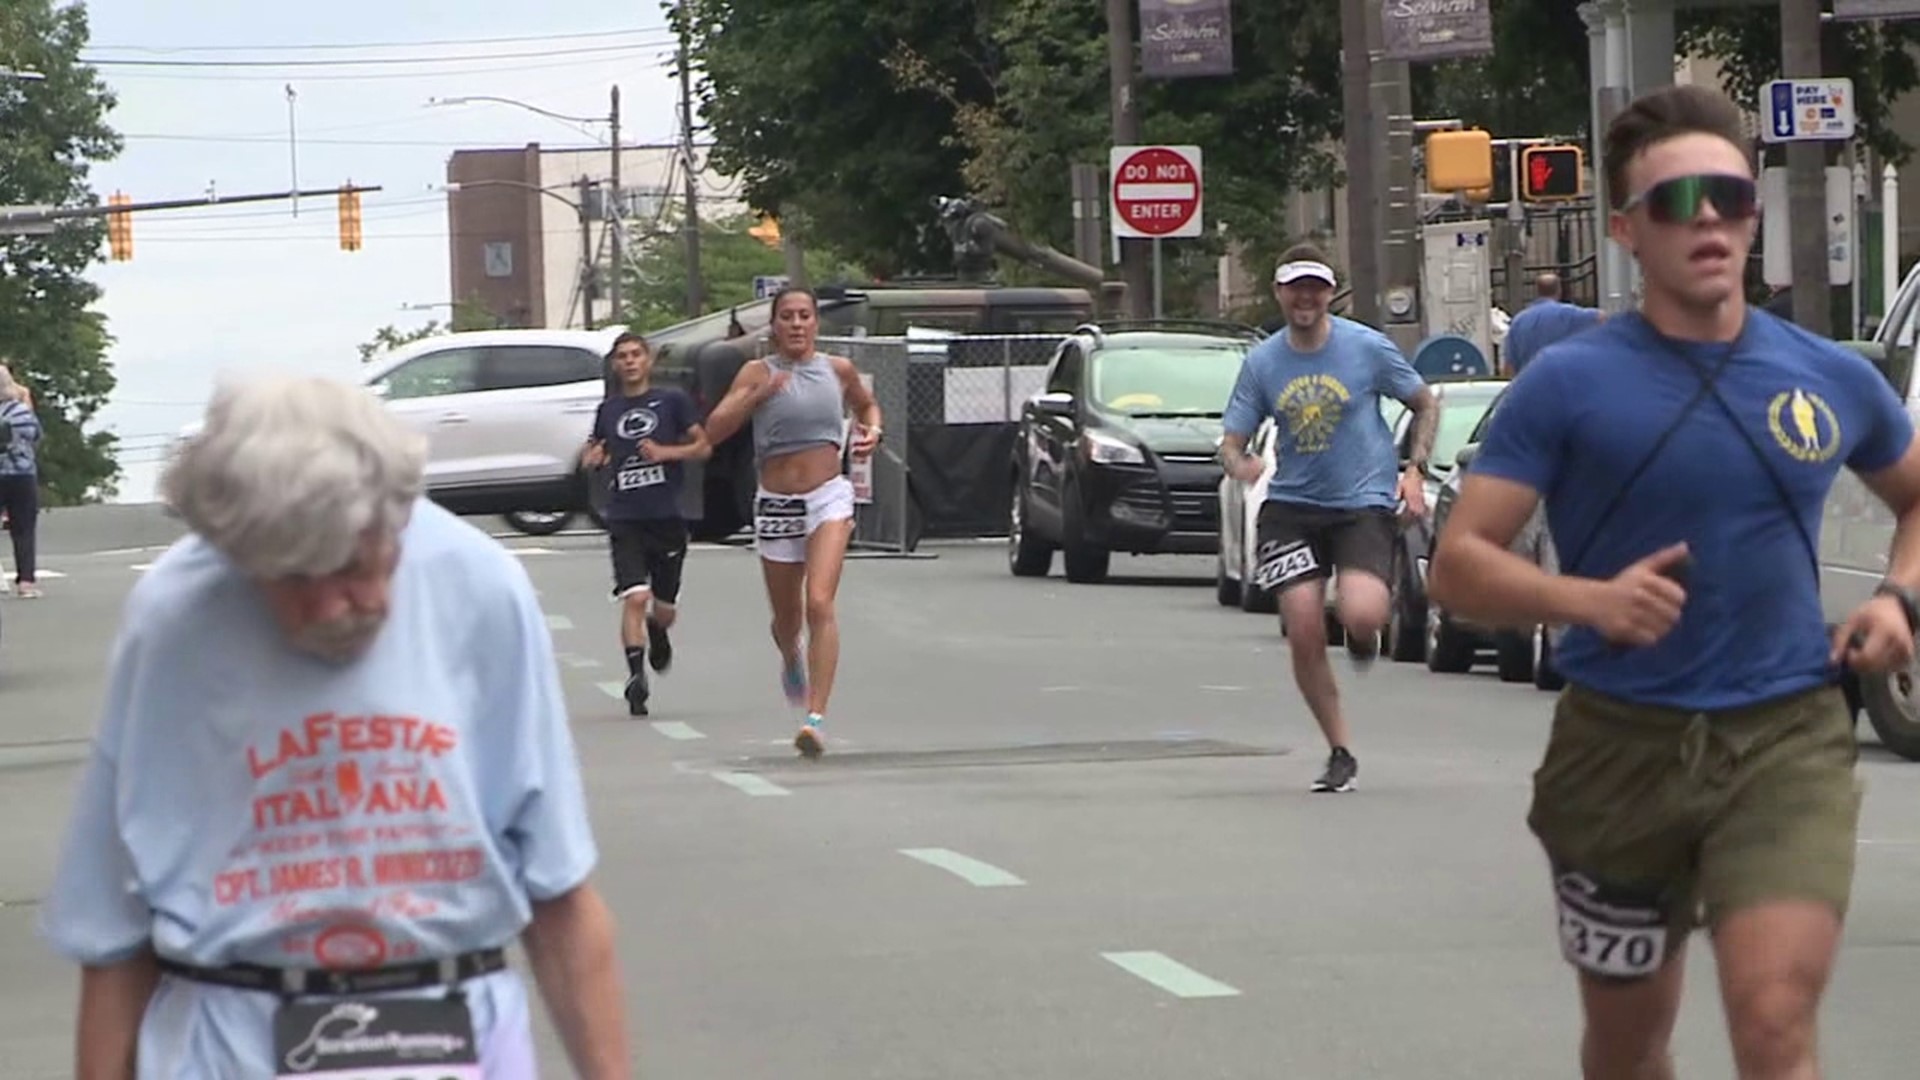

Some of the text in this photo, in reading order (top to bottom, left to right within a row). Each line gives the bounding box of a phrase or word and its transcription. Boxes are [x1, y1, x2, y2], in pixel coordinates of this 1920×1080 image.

[1796, 87, 1819, 95] PAY
[1797, 96, 1826, 105] HERE
[1125, 164, 1188, 180] DO NOT
[1131, 203, 1182, 219] ENTER
[623, 469, 661, 486] 2211
[760, 519, 805, 533] 2229
[1254, 552, 1310, 583] 2243
[270, 855, 342, 896] JAMES
[1560, 914, 1654, 966] 370
